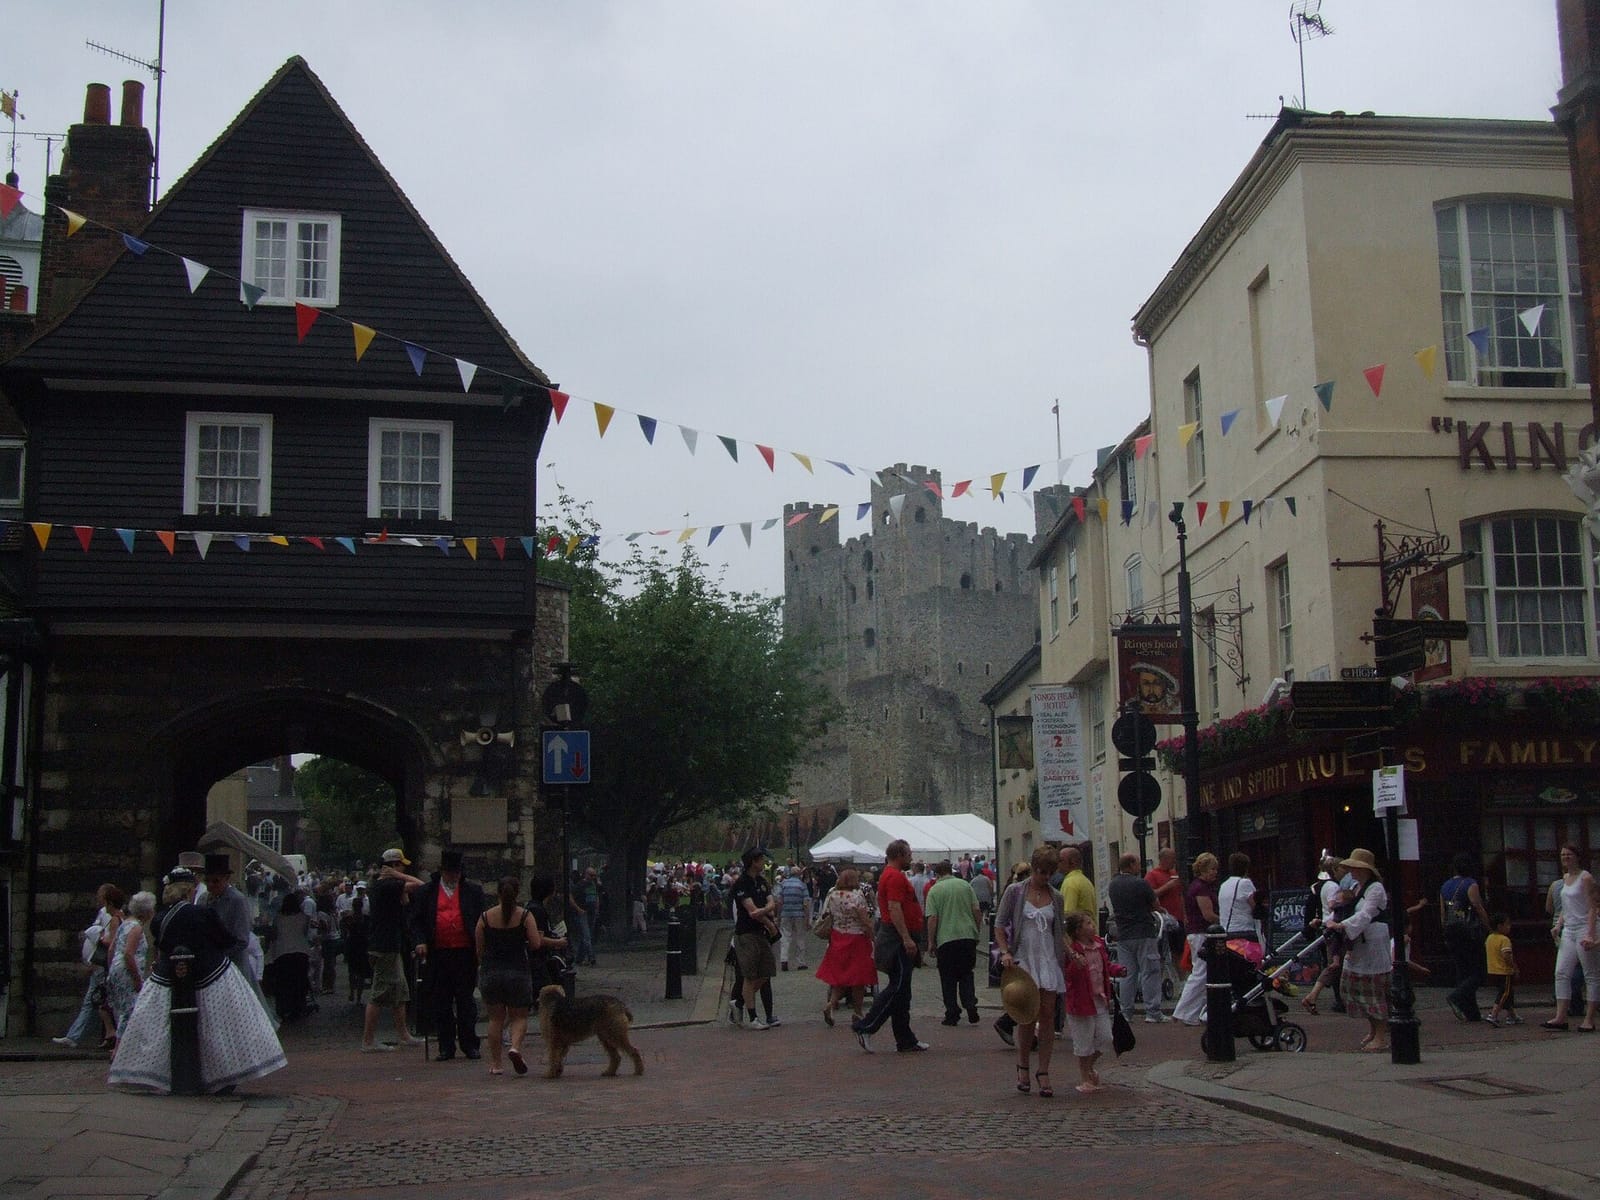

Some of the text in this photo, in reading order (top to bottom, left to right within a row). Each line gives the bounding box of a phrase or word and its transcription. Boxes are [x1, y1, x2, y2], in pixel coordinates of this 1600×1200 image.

[1248, 762, 1289, 795] SPIRIT
[1297, 744, 1426, 783] VAULS
[1460, 739, 1598, 765] FAMILY
